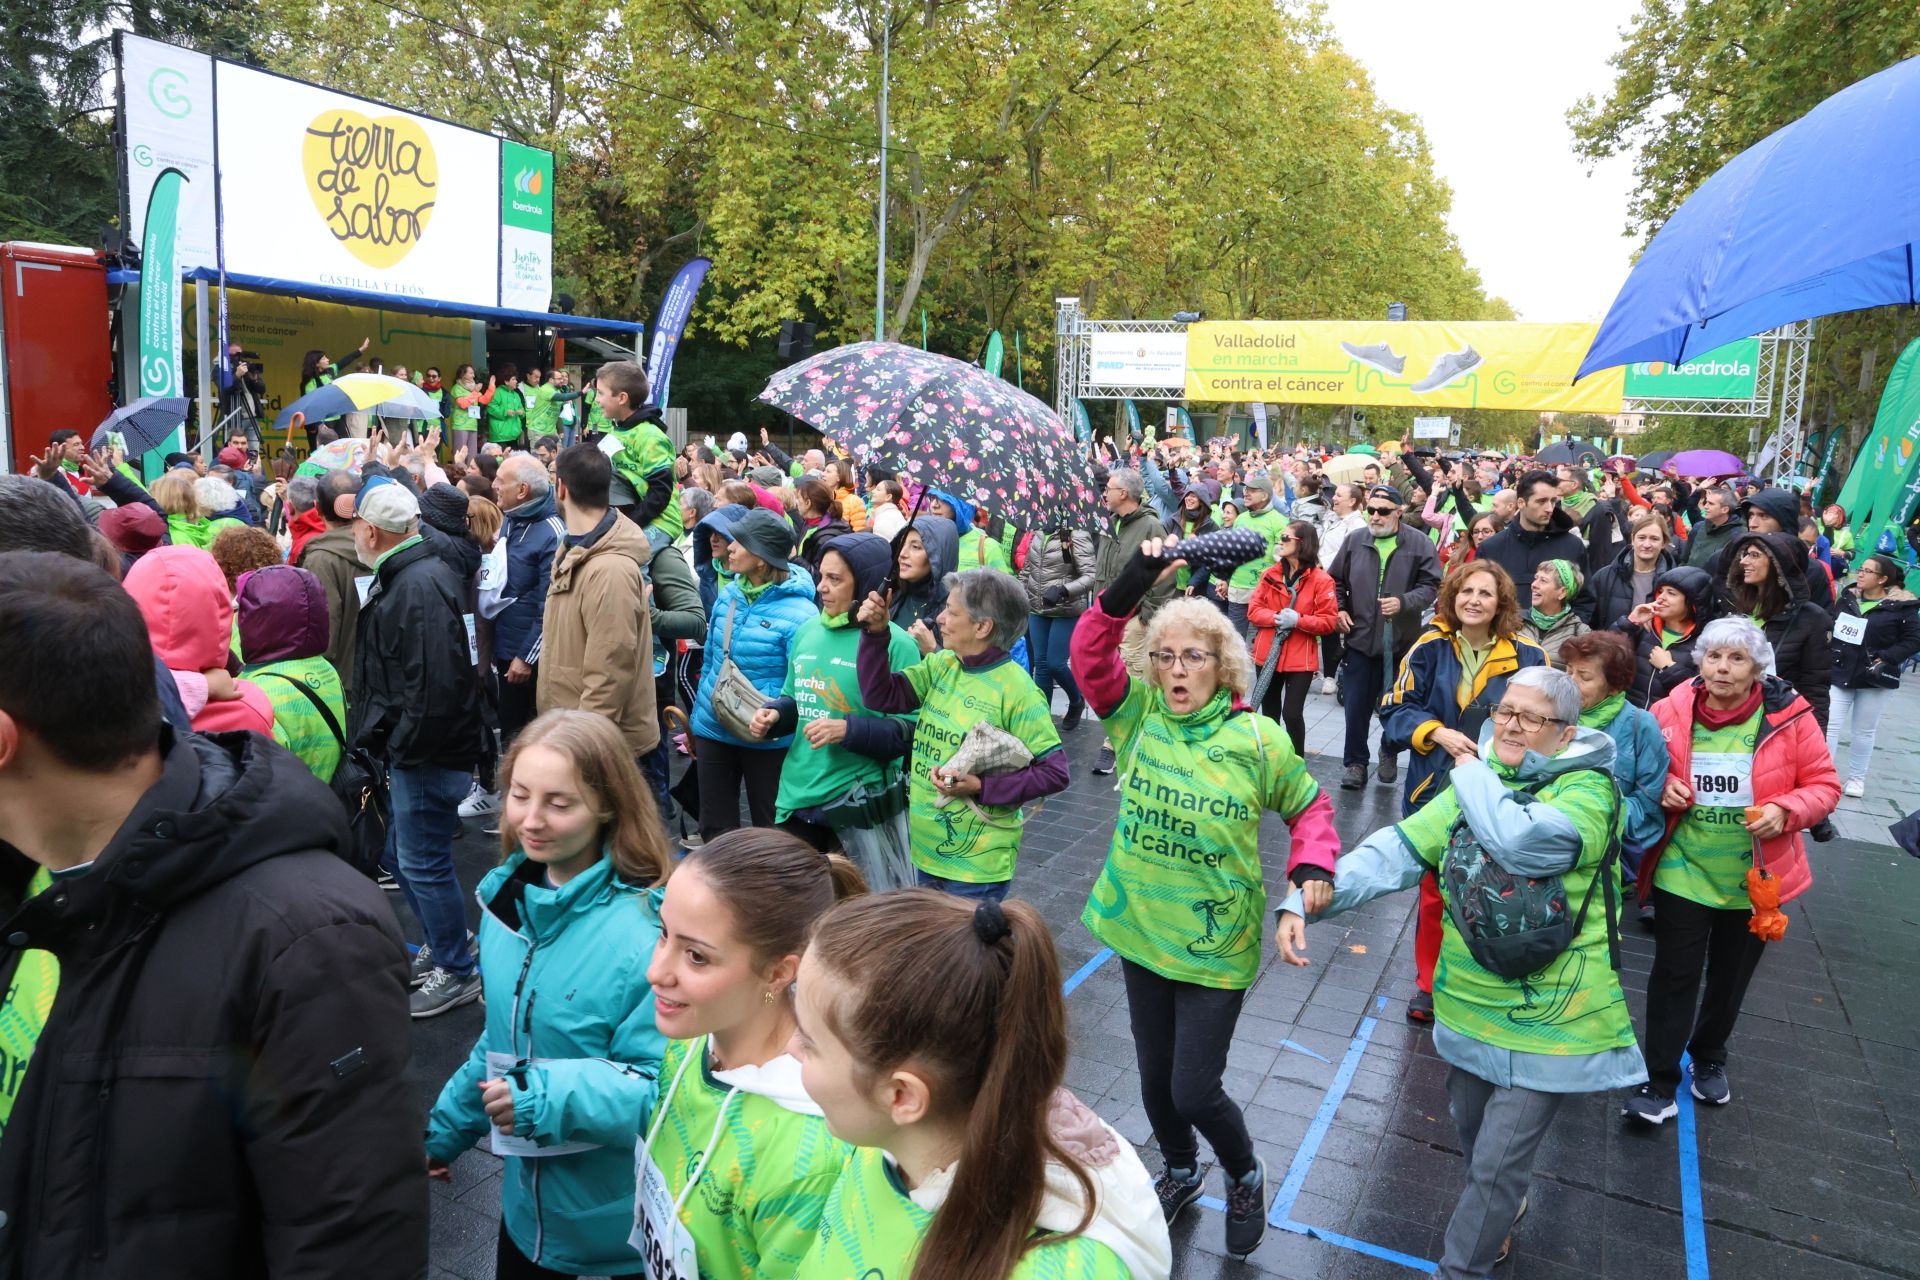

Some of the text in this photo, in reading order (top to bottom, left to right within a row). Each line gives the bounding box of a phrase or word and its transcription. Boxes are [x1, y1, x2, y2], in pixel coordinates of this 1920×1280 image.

[306, 117, 435, 187] tierra
[318, 167, 360, 196] de
[327, 172, 435, 246] sabor
[319, 273, 425, 295] CASTILLA Y LEÓN
[160, 281, 168, 352] en Valladolid
[1214, 334, 1296, 349] Valladolid
[1097, 361, 1125, 370] FMD
[1212, 352, 1298, 366] en marcha
[1211, 376, 1344, 392] contra el cáncer
[794, 676, 826, 691] archa
[912, 737, 942, 762] ontra
[1155, 783, 1249, 823] marcha
[1126, 798, 1196, 839] contra
[1141, 834, 1228, 869] cáncer
